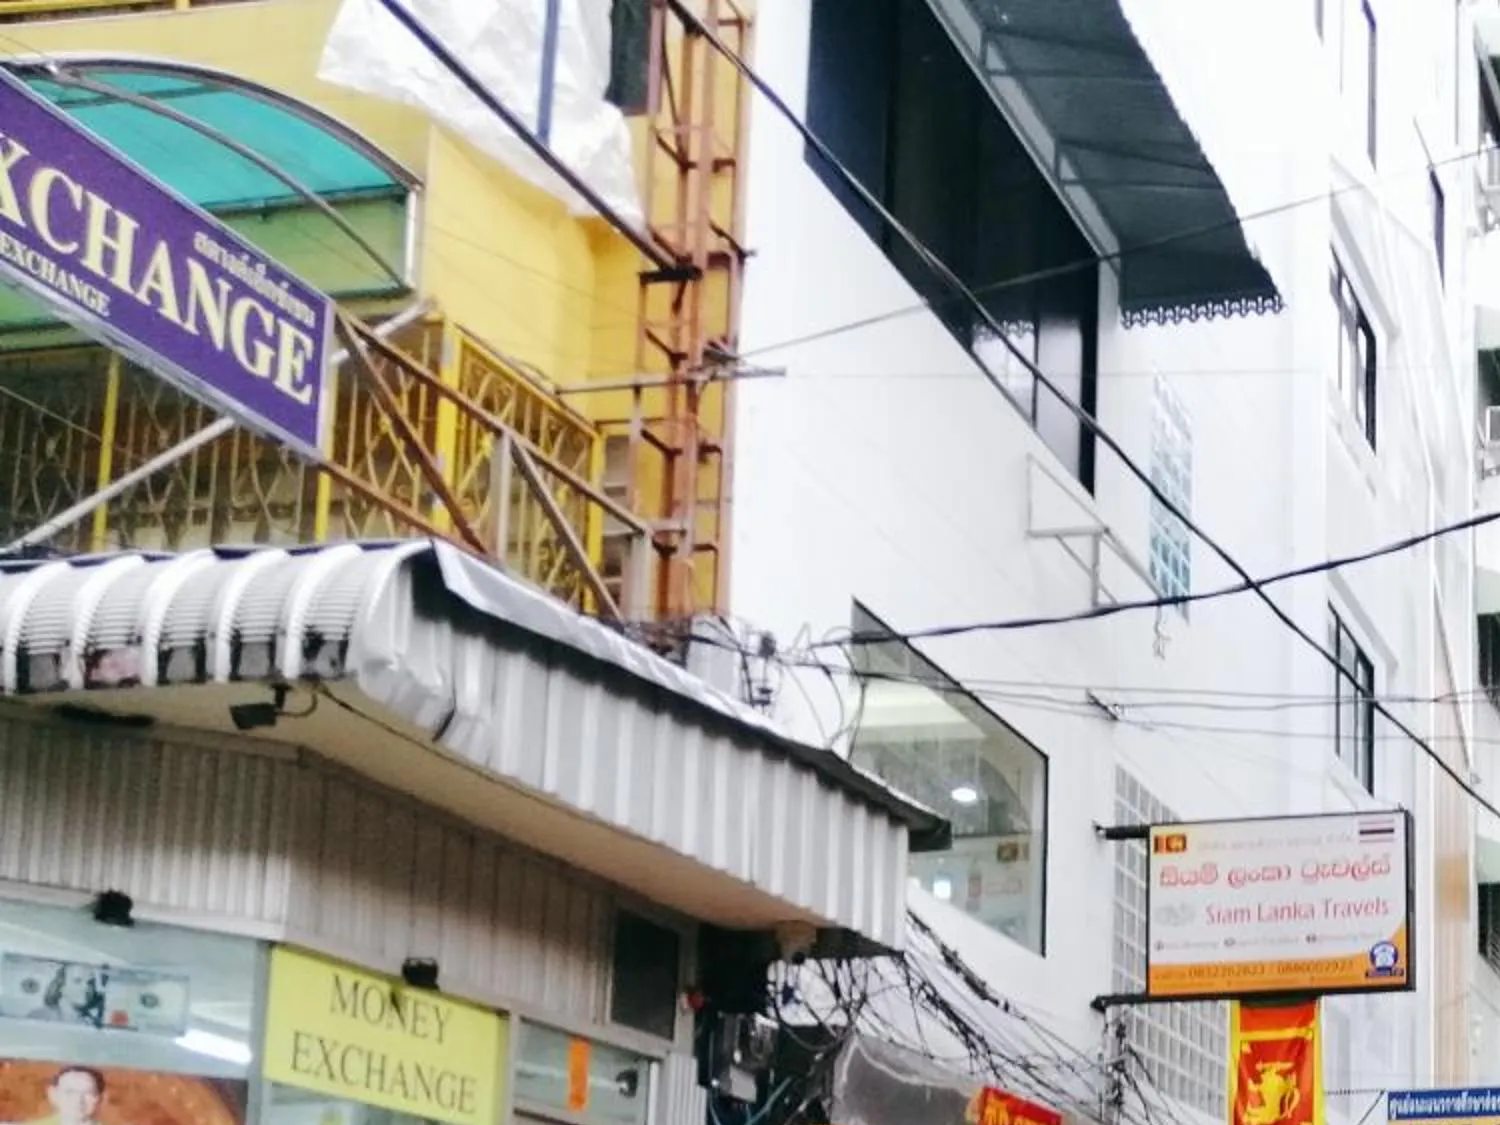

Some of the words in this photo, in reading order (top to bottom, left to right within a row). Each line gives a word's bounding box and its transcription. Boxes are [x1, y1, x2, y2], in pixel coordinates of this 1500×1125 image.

[1205, 902, 1251, 926] Siam
[1257, 899, 1316, 922] Lanka
[1322, 896, 1389, 920] Travels
[328, 974, 454, 1047] MONEY
[289, 1031, 479, 1116] EXCHANGE
